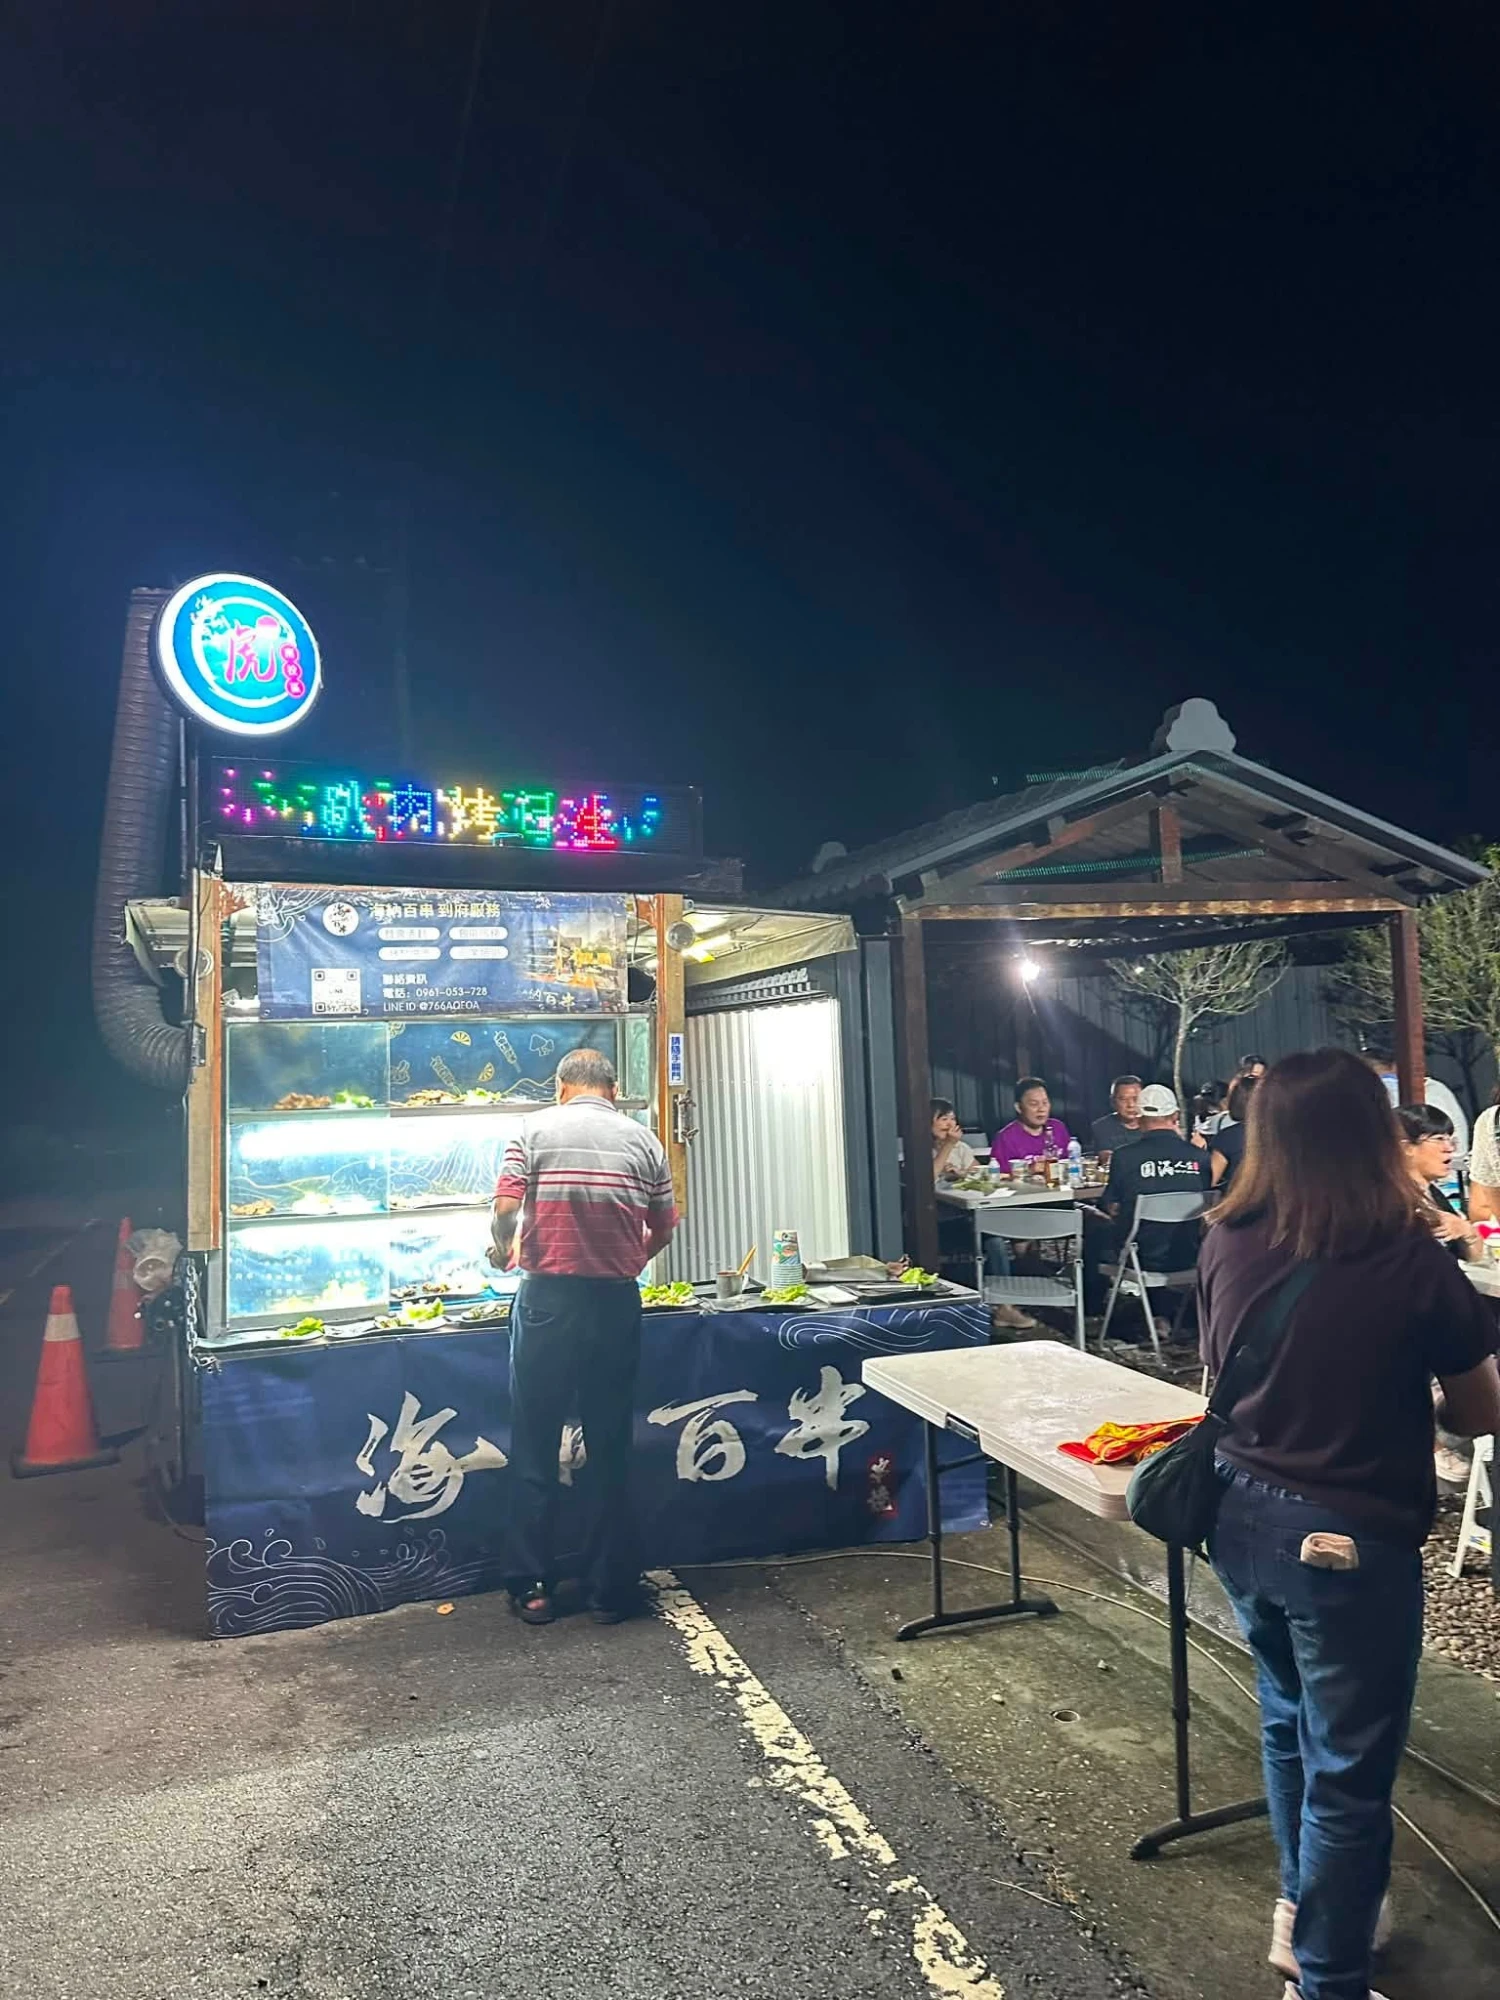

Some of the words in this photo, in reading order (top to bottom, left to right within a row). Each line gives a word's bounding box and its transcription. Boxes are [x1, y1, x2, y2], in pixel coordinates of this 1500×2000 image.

[437, 903, 500, 918] 到府服務
[384, 1002, 404, 1011] LINE
[406, 1002, 415, 1011] ID
[356, 1365, 870, 1523] 海百串
